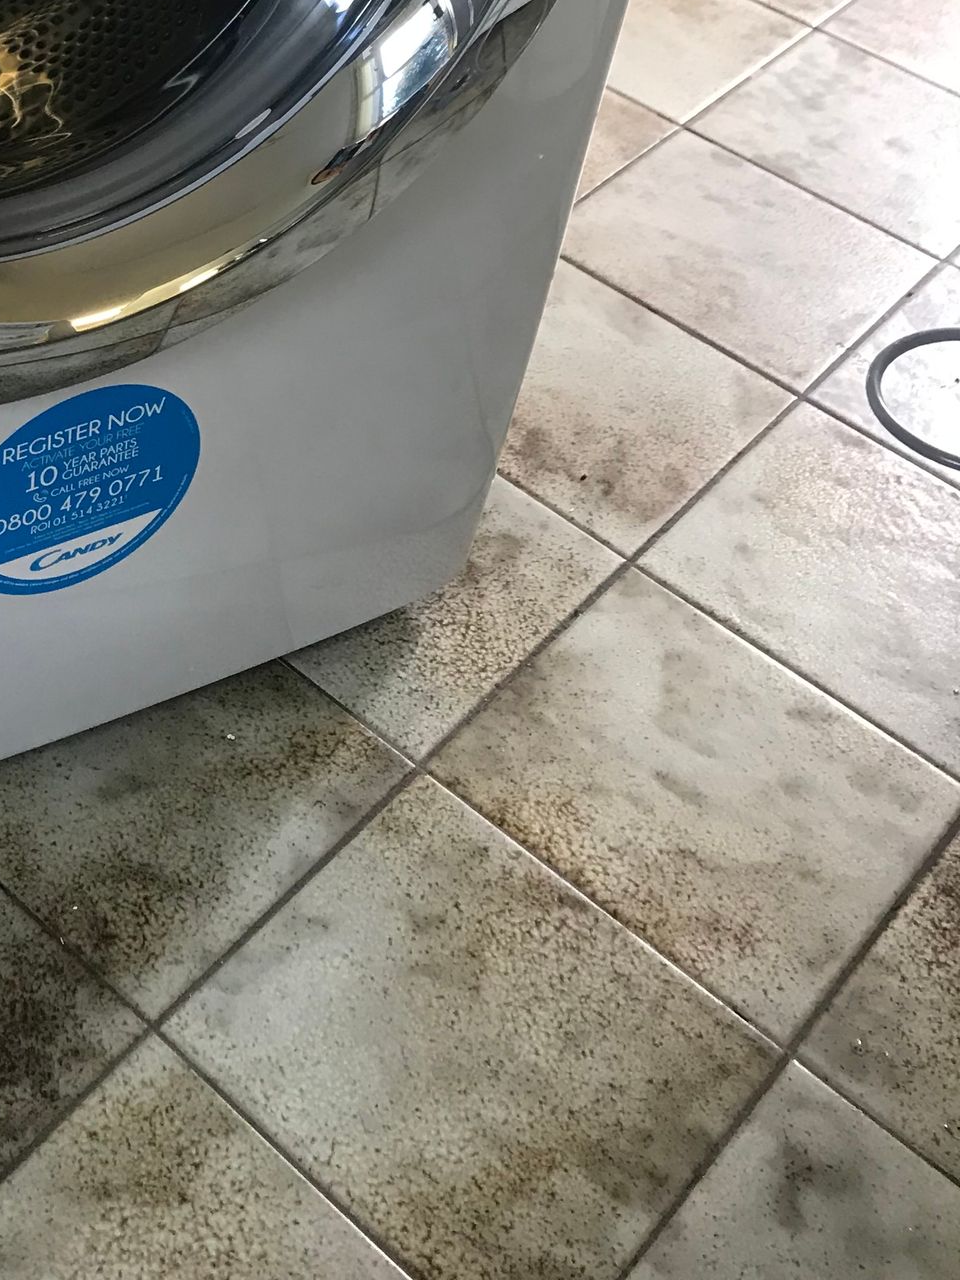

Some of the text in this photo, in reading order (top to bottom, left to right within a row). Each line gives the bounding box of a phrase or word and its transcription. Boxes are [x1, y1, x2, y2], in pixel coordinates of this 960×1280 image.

[2, 419, 101, 465] REGISTER
[107, 396, 166, 430] NOW
[79, 433, 114, 450] YOUR
[26, 437, 137, 493] 10 YEAR PARTS
[51, 465, 130, 497] CALL FREE NOW
[62, 446, 139, 480] GUARANTEE
[60, 486, 102, 512] 479
[109, 464, 164, 495] 0771
[30, 519, 50, 535] ROI
[53, 515, 66, 526] 01
[71, 506, 92, 521] 514
[30, 532, 124, 571] CANDY
